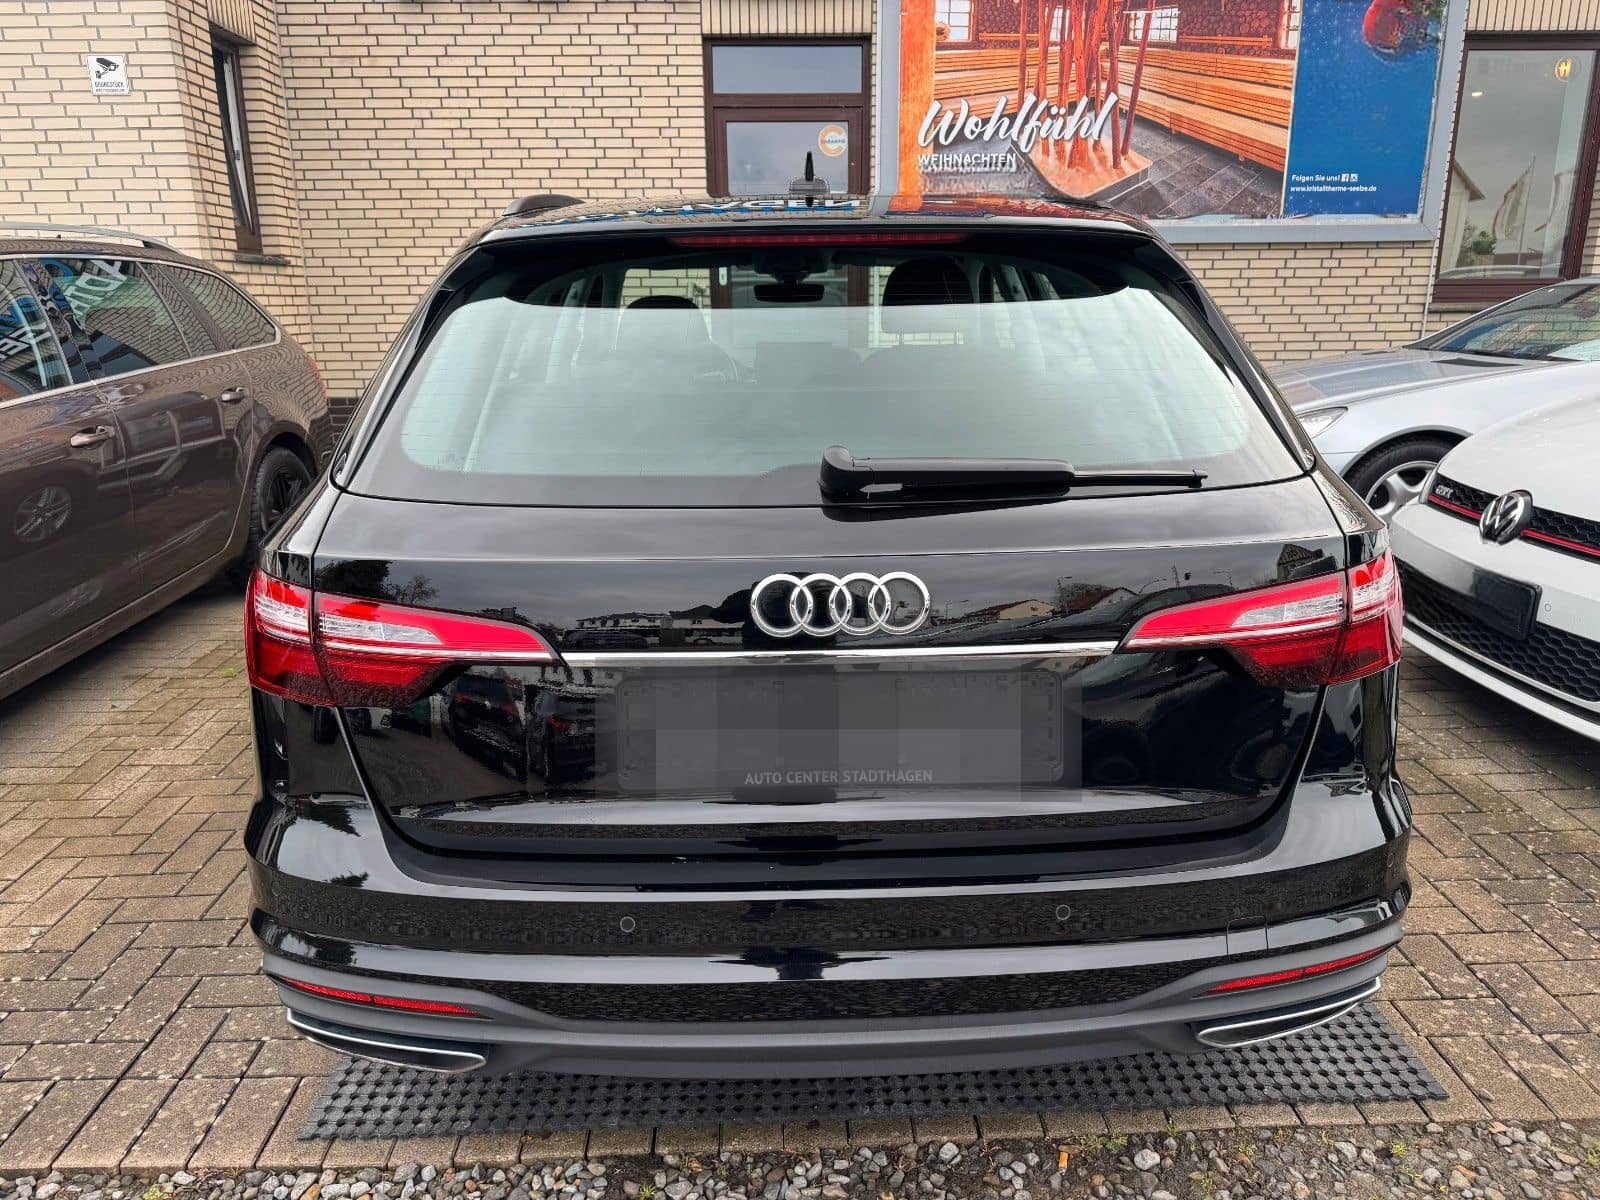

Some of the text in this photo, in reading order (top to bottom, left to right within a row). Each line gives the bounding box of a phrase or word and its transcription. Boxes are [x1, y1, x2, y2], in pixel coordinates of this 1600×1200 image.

[917, 92, 1118, 152] Wohlfühl
[918, 153, 1016, 164] WEIHNACHTEN
[1291, 174, 1314, 182] Folgen
[745, 769, 933, 784] AUTO CENTER STADTHAGEN
